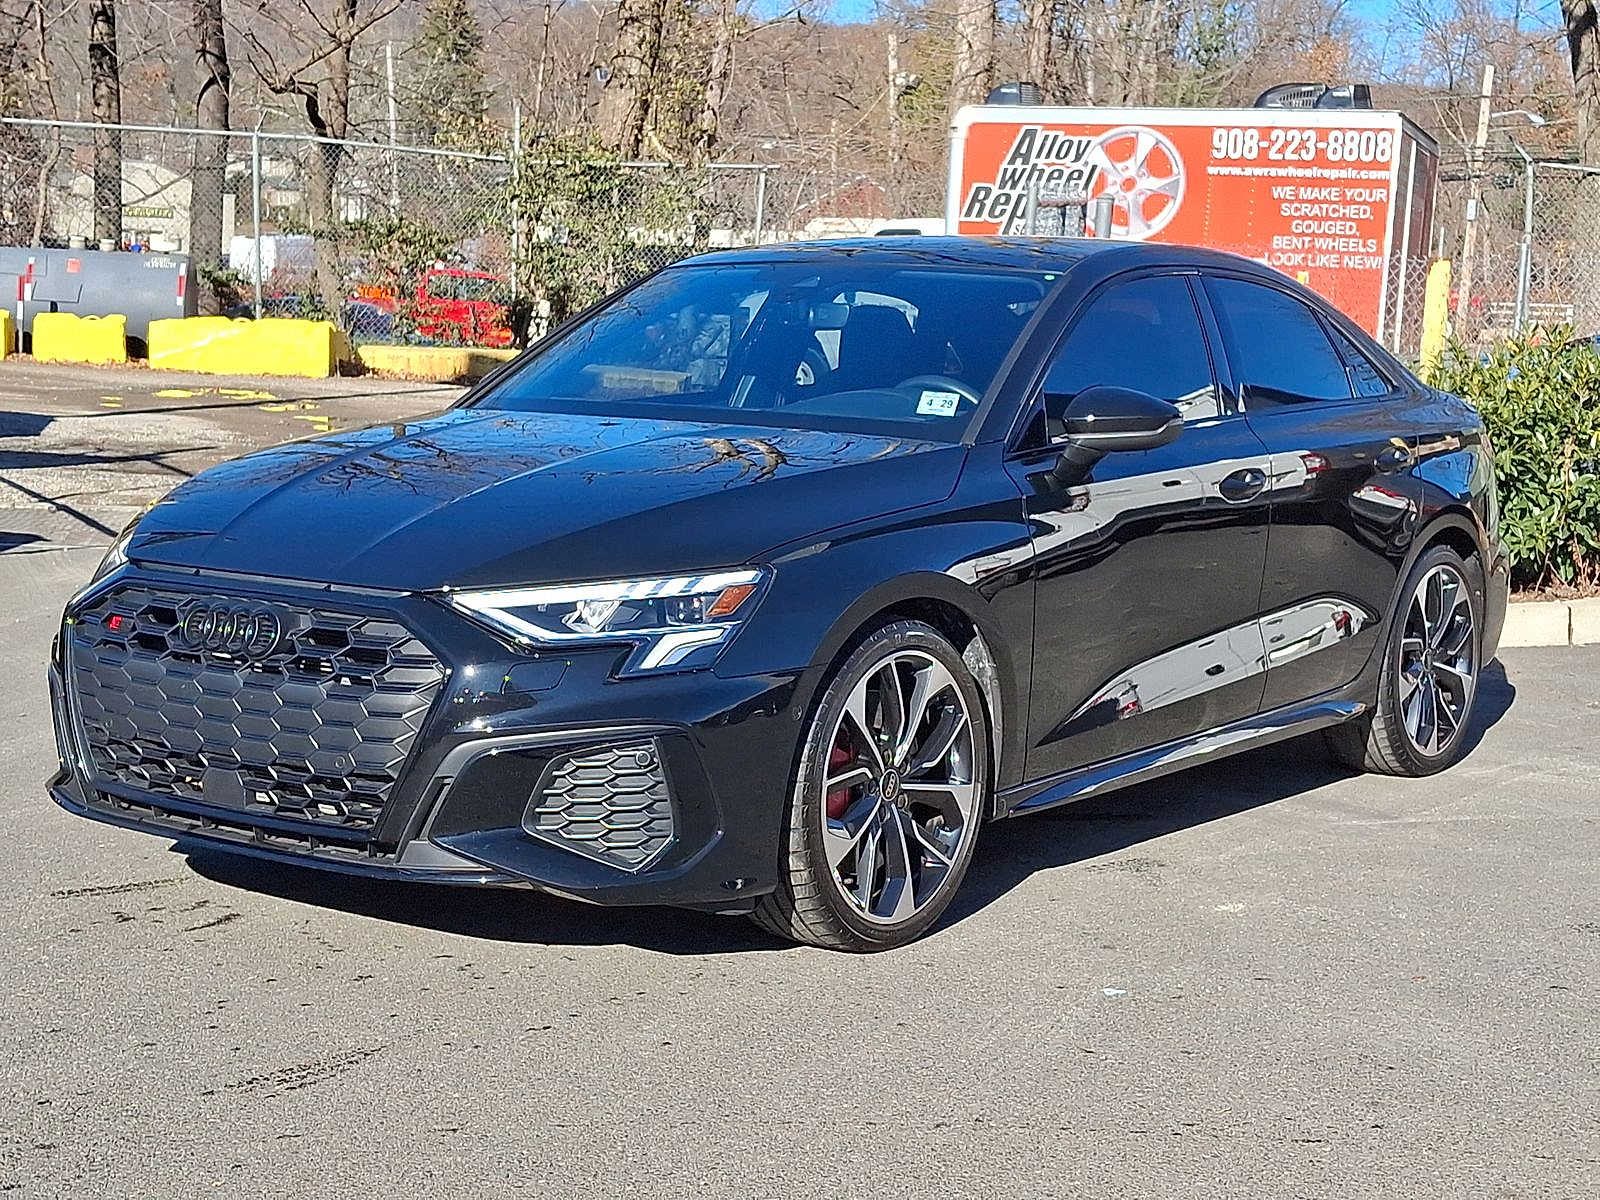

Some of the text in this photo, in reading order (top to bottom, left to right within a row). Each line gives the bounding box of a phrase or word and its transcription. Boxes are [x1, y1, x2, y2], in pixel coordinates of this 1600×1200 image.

[1006, 128, 1093, 166] Alloy
[1211, 127, 1393, 163] 908-223-8808
[998, 162, 1099, 191] wheel
[1272, 186, 1388, 203] WE MAKE YOUR
[1272, 236, 1377, 252] BENT WHEELS
[1264, 252, 1305, 267] LOOK
[1308, 254, 1341, 268] LIKE
